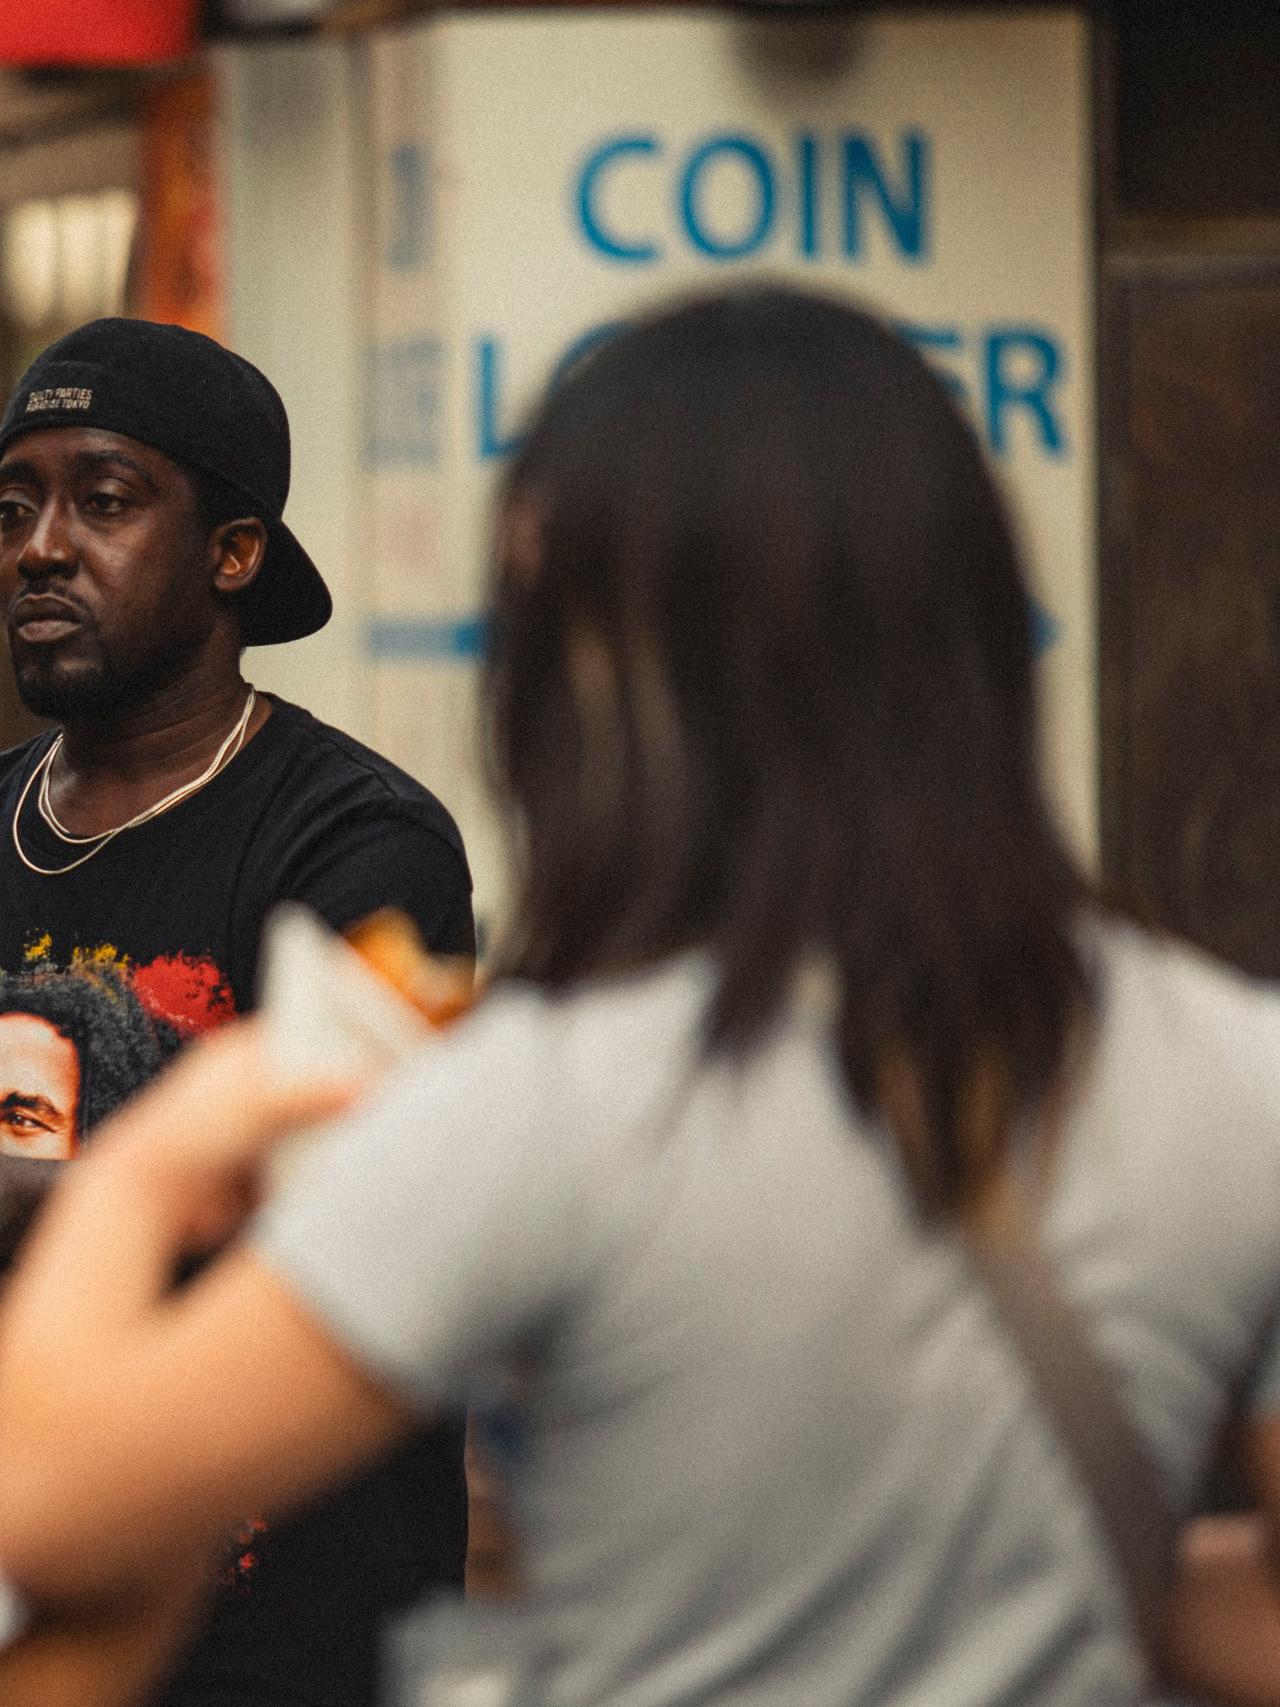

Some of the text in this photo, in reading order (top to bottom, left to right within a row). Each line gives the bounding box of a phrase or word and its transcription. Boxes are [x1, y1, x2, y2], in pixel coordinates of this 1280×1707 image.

[574, 130, 930, 262] COIN
[56, 388, 93, 400] PARTIES
[62, 399, 90, 409] TOKYO
